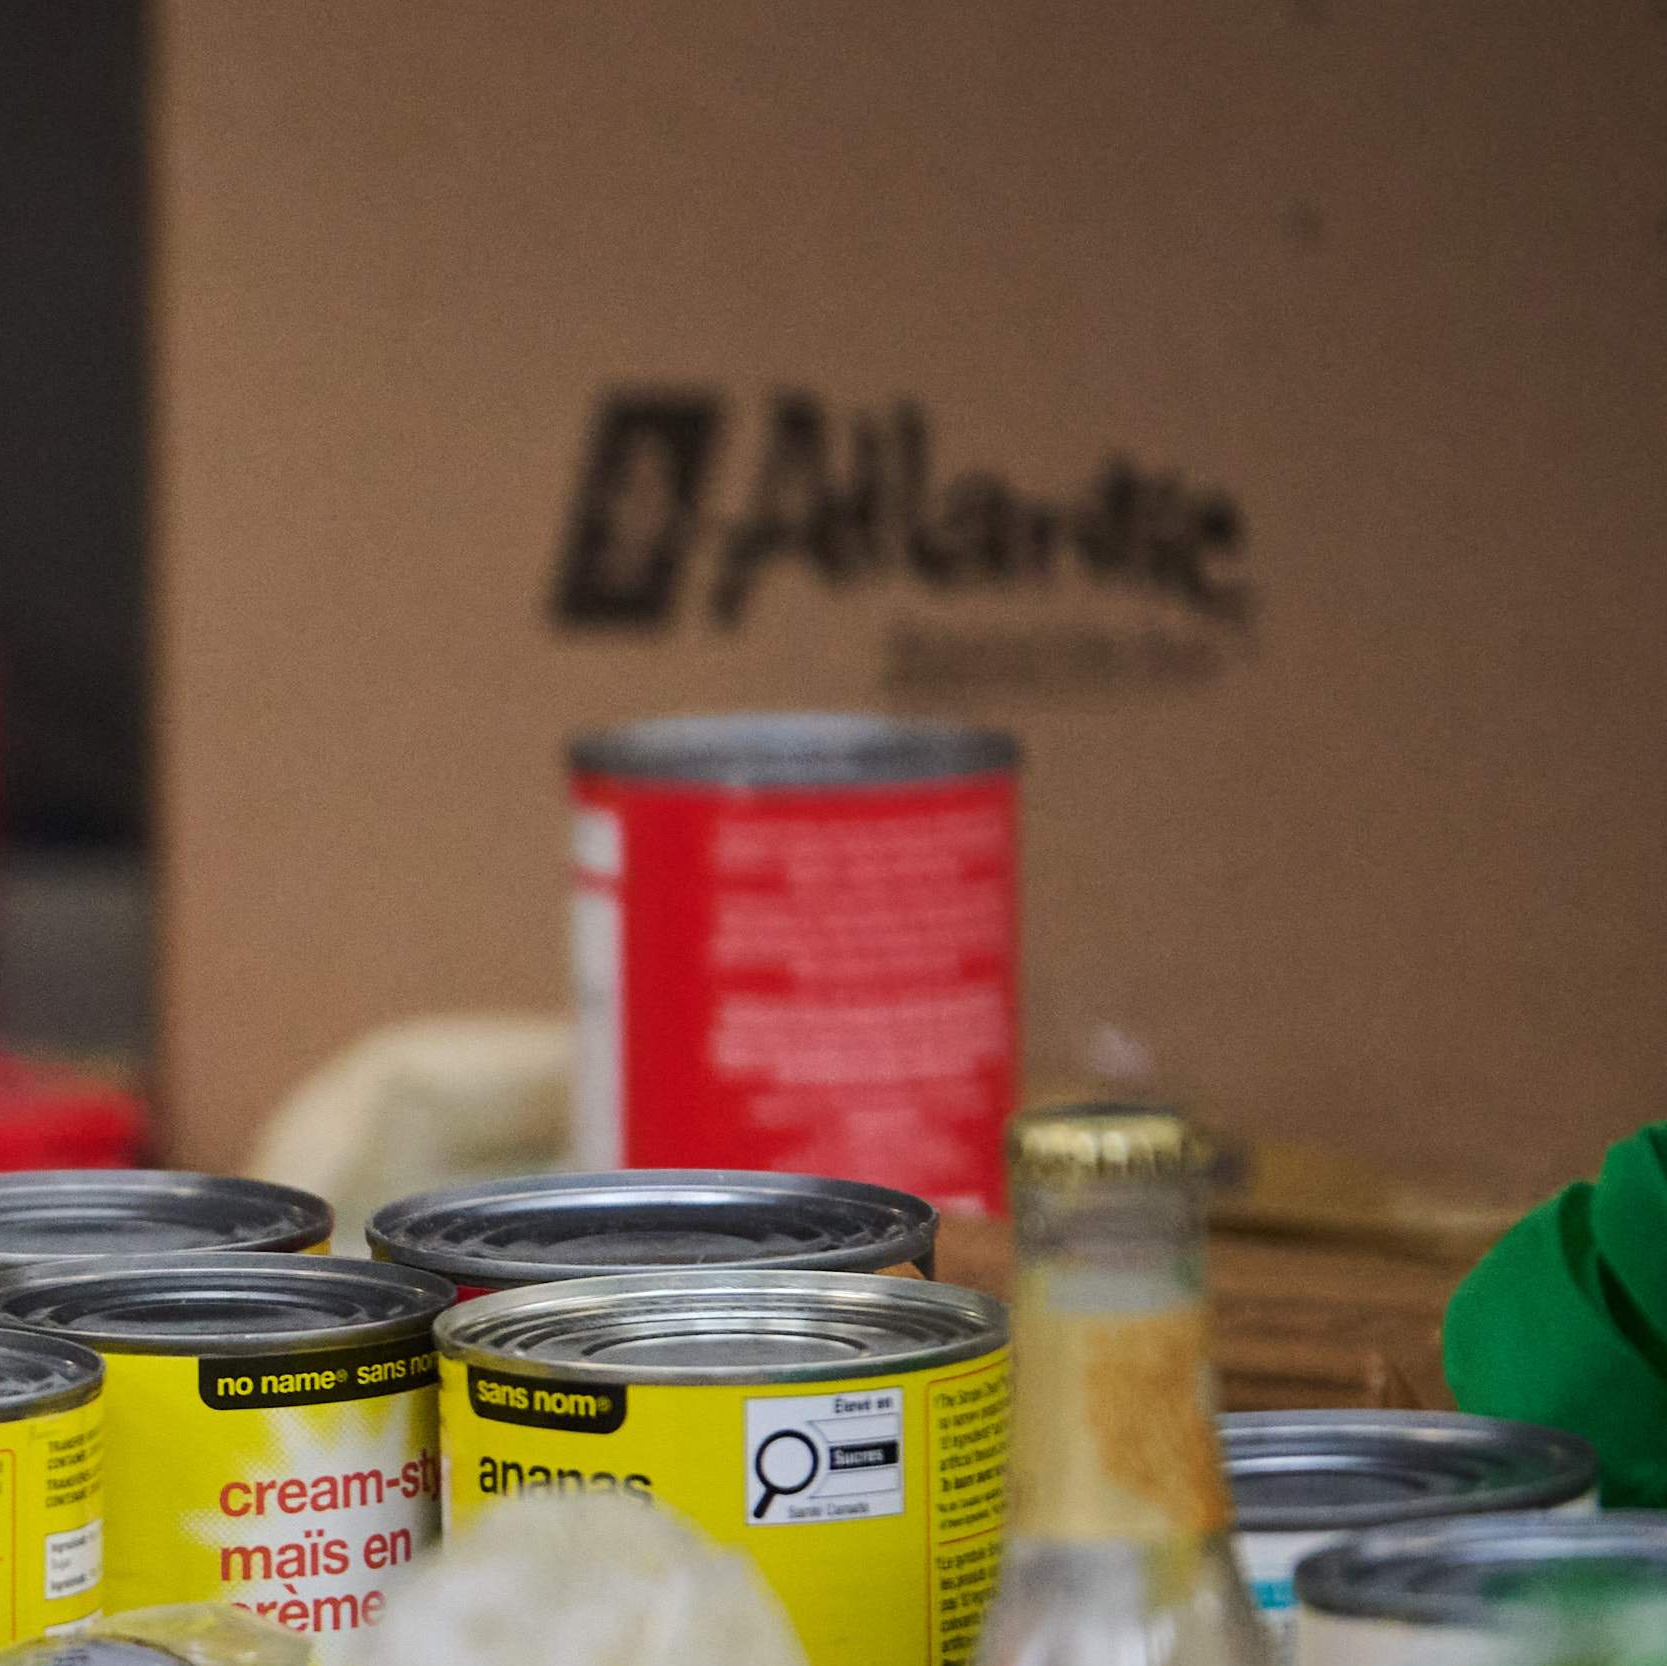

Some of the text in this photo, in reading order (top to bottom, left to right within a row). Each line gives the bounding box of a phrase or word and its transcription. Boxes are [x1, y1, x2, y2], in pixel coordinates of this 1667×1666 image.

[216, 1374, 254, 1397] no
[356, 1359, 406, 1385] sans
[476, 1379, 529, 1409] sans
[834, 1449, 885, 1467] Sucres
[220, 1528, 412, 1581] maïs en
